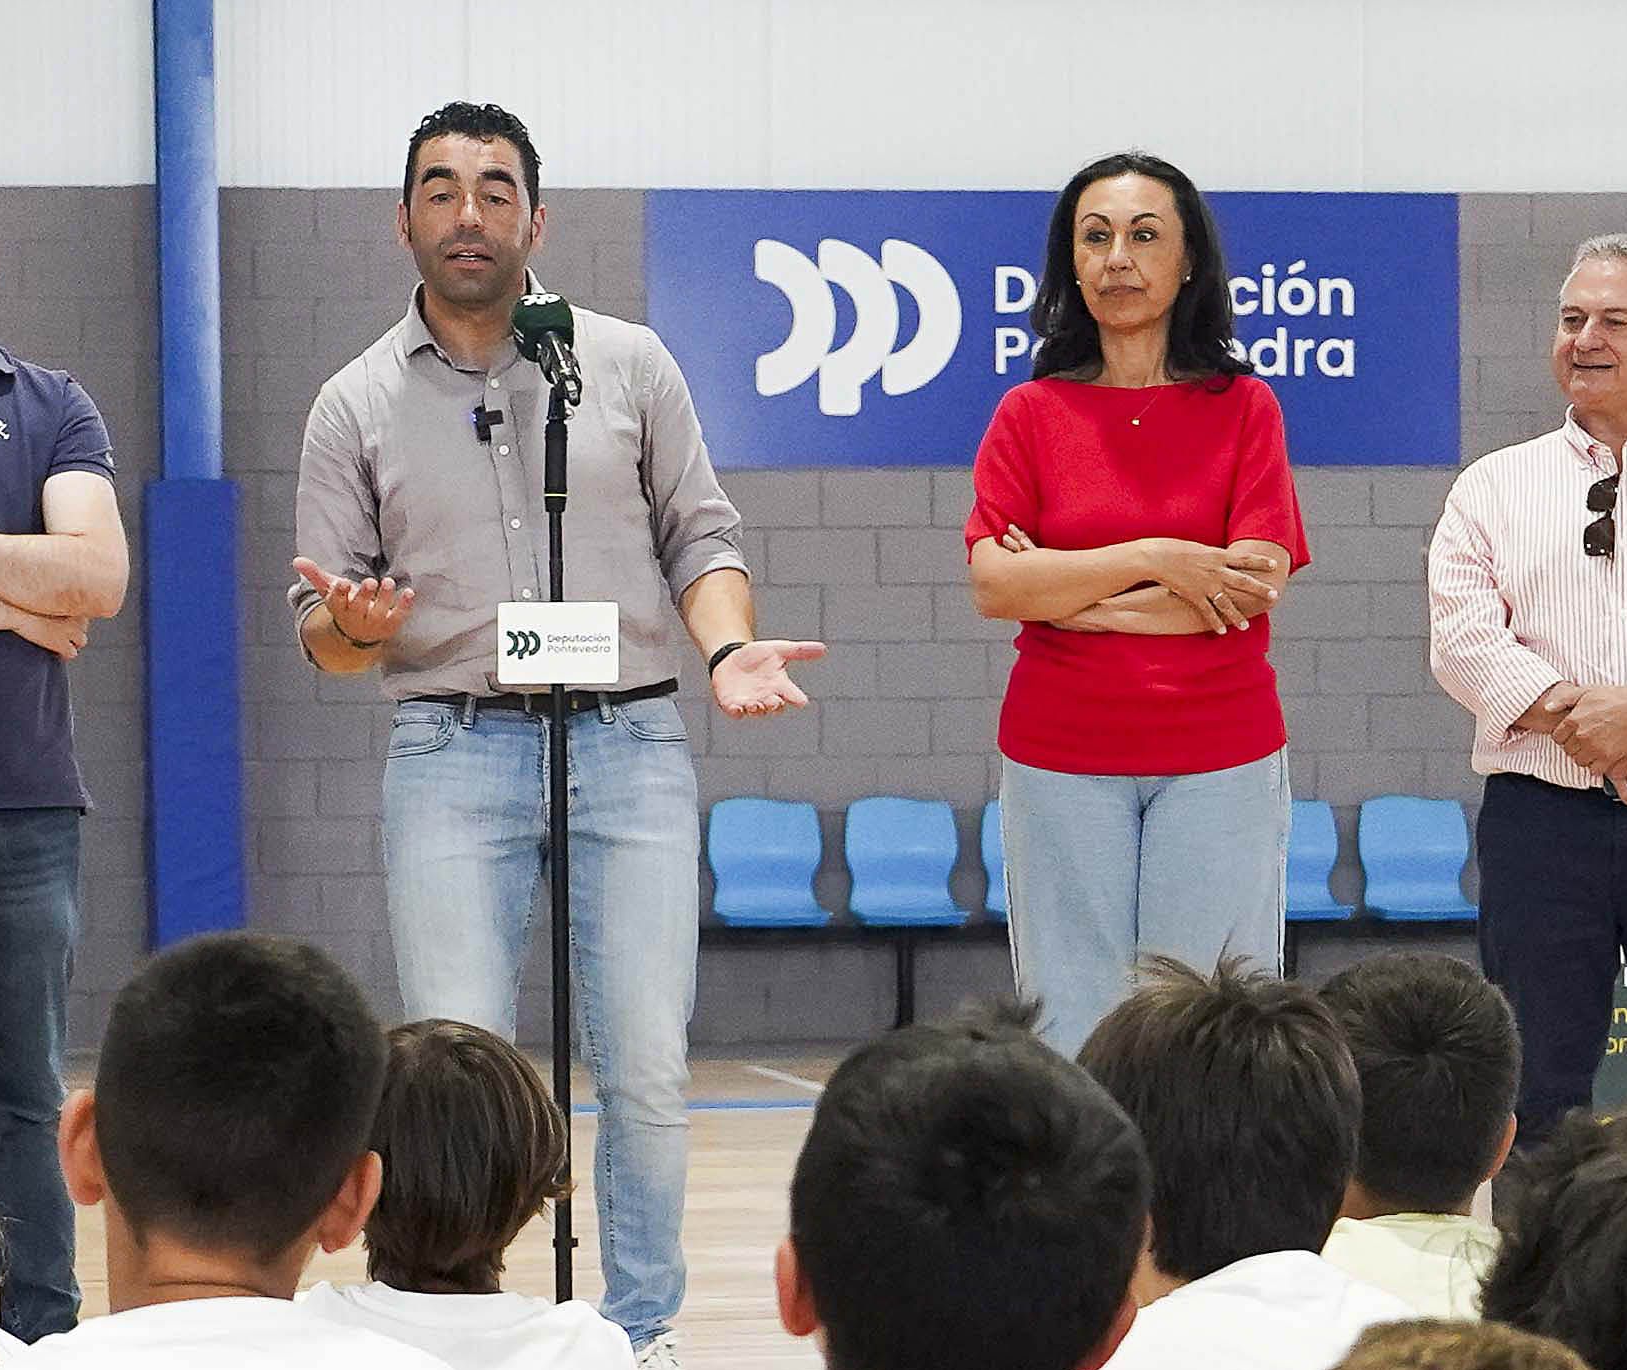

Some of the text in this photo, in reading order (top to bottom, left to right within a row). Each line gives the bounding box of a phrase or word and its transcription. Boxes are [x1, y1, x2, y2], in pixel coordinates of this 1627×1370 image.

[994, 260, 1355, 316] Dción
[546, 633, 611, 644] Deputación
[546, 644, 611, 654] Pontevedra
